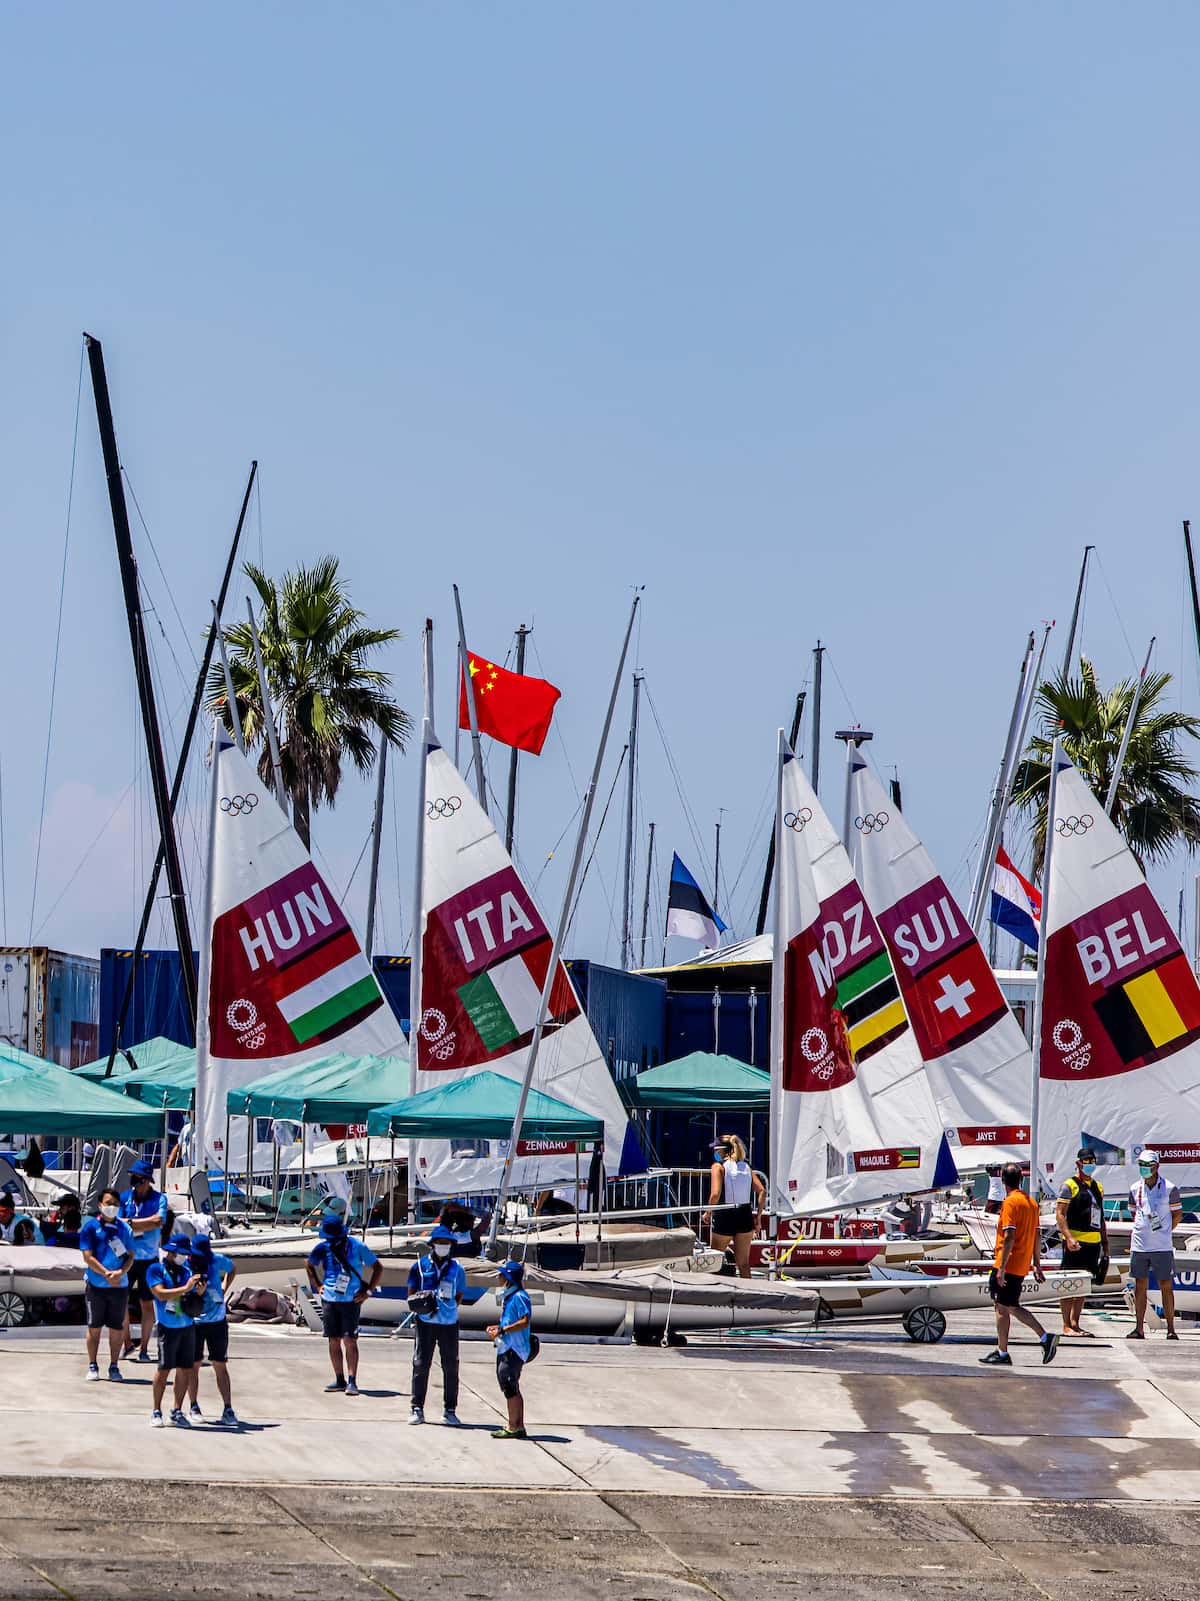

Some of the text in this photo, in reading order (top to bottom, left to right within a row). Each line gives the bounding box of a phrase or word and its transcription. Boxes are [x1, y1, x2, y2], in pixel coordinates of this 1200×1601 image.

[238, 882, 333, 971] HUN
[454, 891, 534, 964] ITA
[893, 896, 960, 966] SUI
[808, 900, 872, 998] MOZ
[1076, 910, 1167, 985] BEL
[237, 1030, 255, 1044] TOKYO
[429, 1040, 444, 1055] TOKYO
[1062, 1051, 1079, 1065] TOKYO
[976, 1131, 998, 1141] JAYET
[788, 1219, 823, 1239] SUI
[1021, 1283, 1040, 1294] 020
